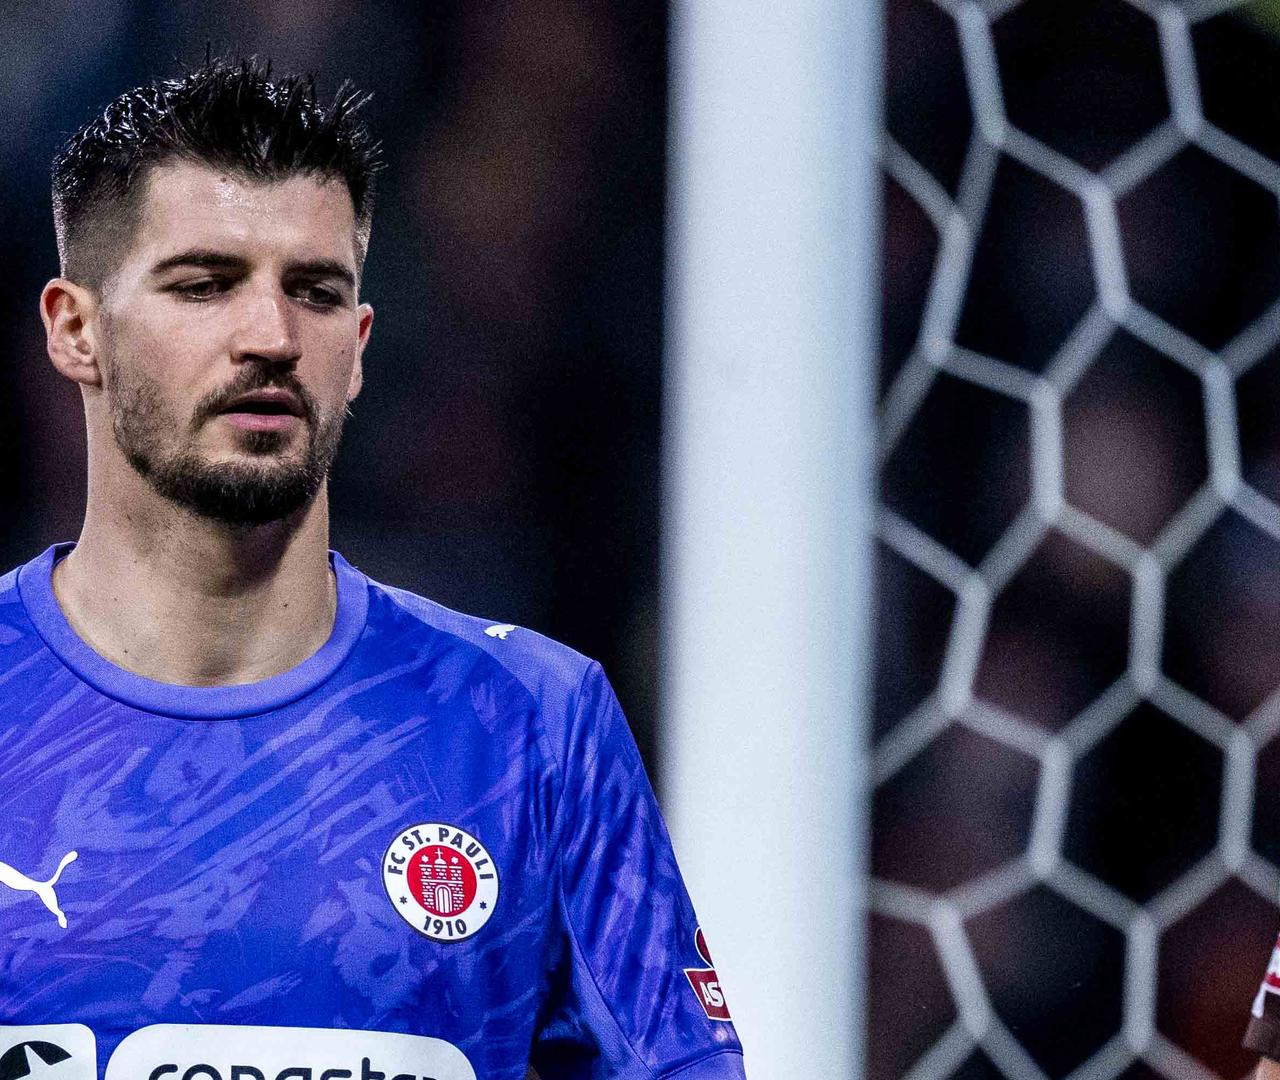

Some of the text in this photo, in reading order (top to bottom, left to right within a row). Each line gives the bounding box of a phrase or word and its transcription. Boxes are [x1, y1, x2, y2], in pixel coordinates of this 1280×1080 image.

[387, 827, 495, 880] FC ST. PAULI
[423, 915, 468, 937] 1910
